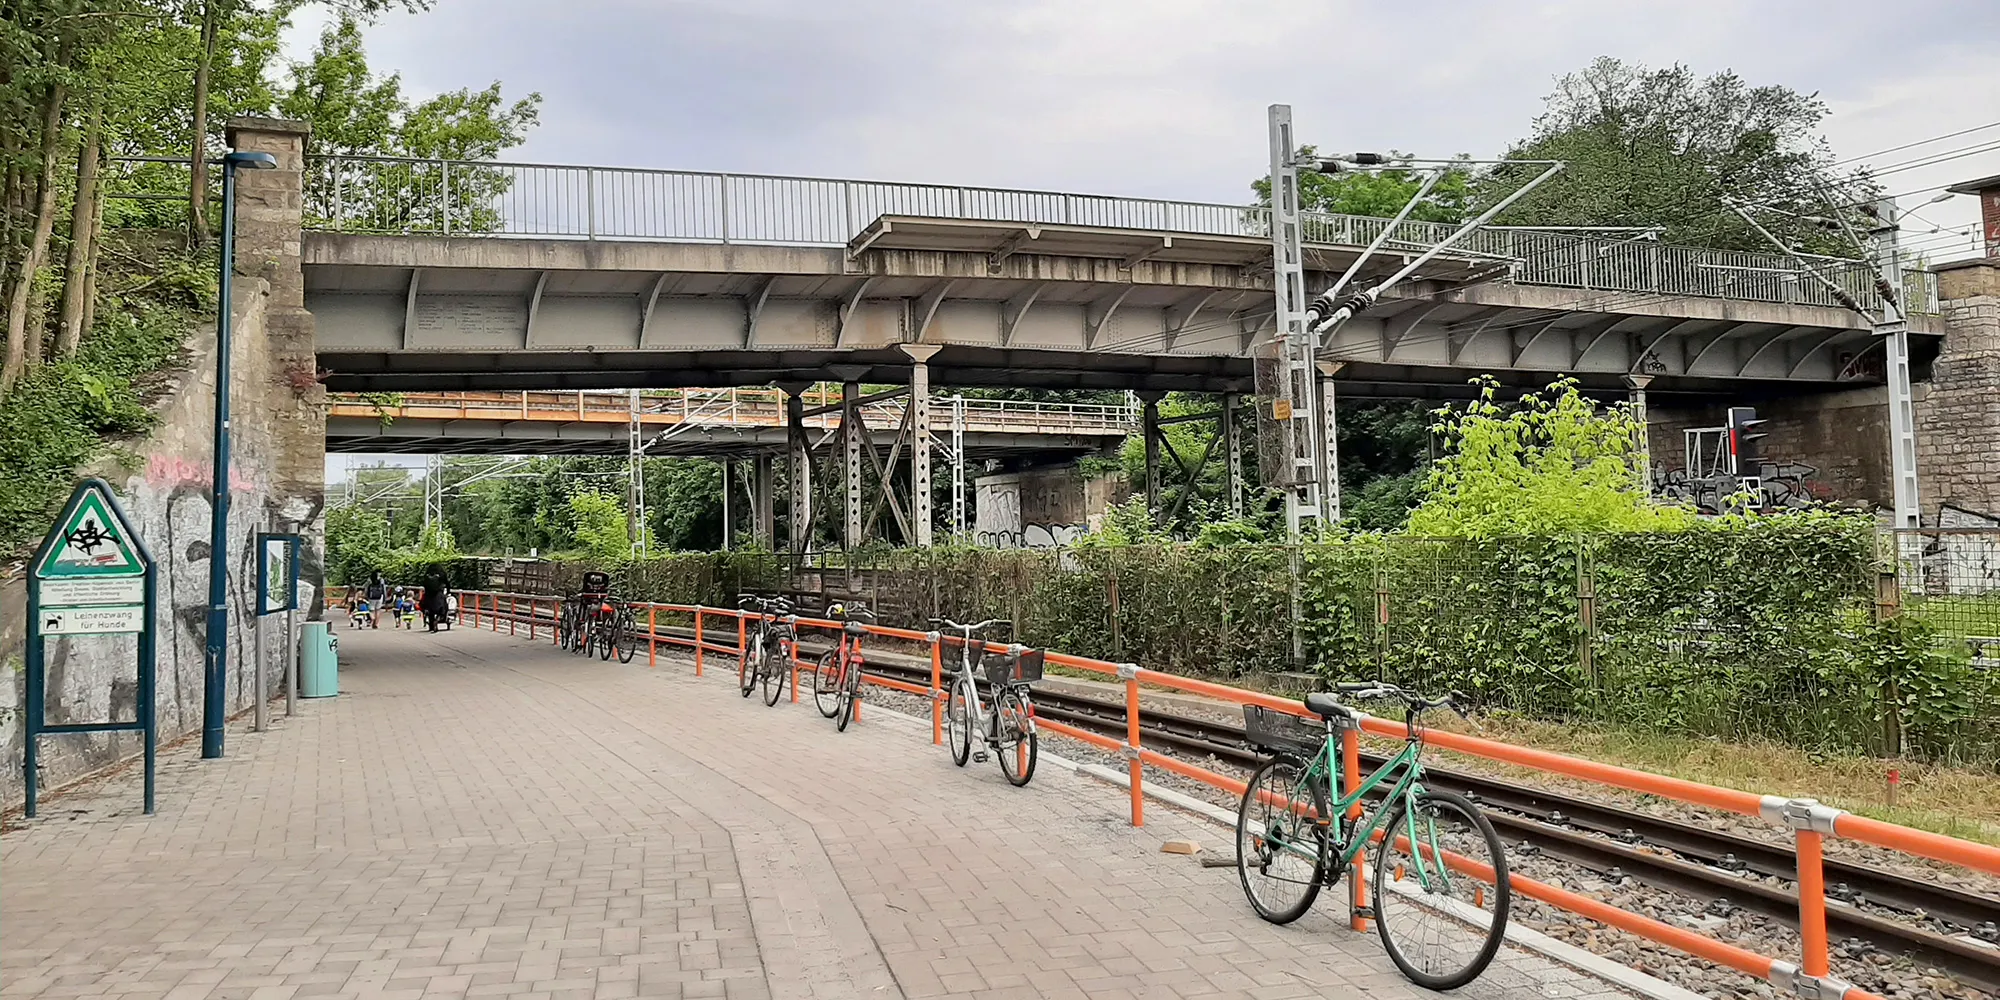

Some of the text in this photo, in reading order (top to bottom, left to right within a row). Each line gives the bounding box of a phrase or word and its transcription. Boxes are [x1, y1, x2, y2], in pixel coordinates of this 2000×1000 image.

[74, 611, 133, 620] Leinenzwang
[80, 620, 126, 629] für Hunde
